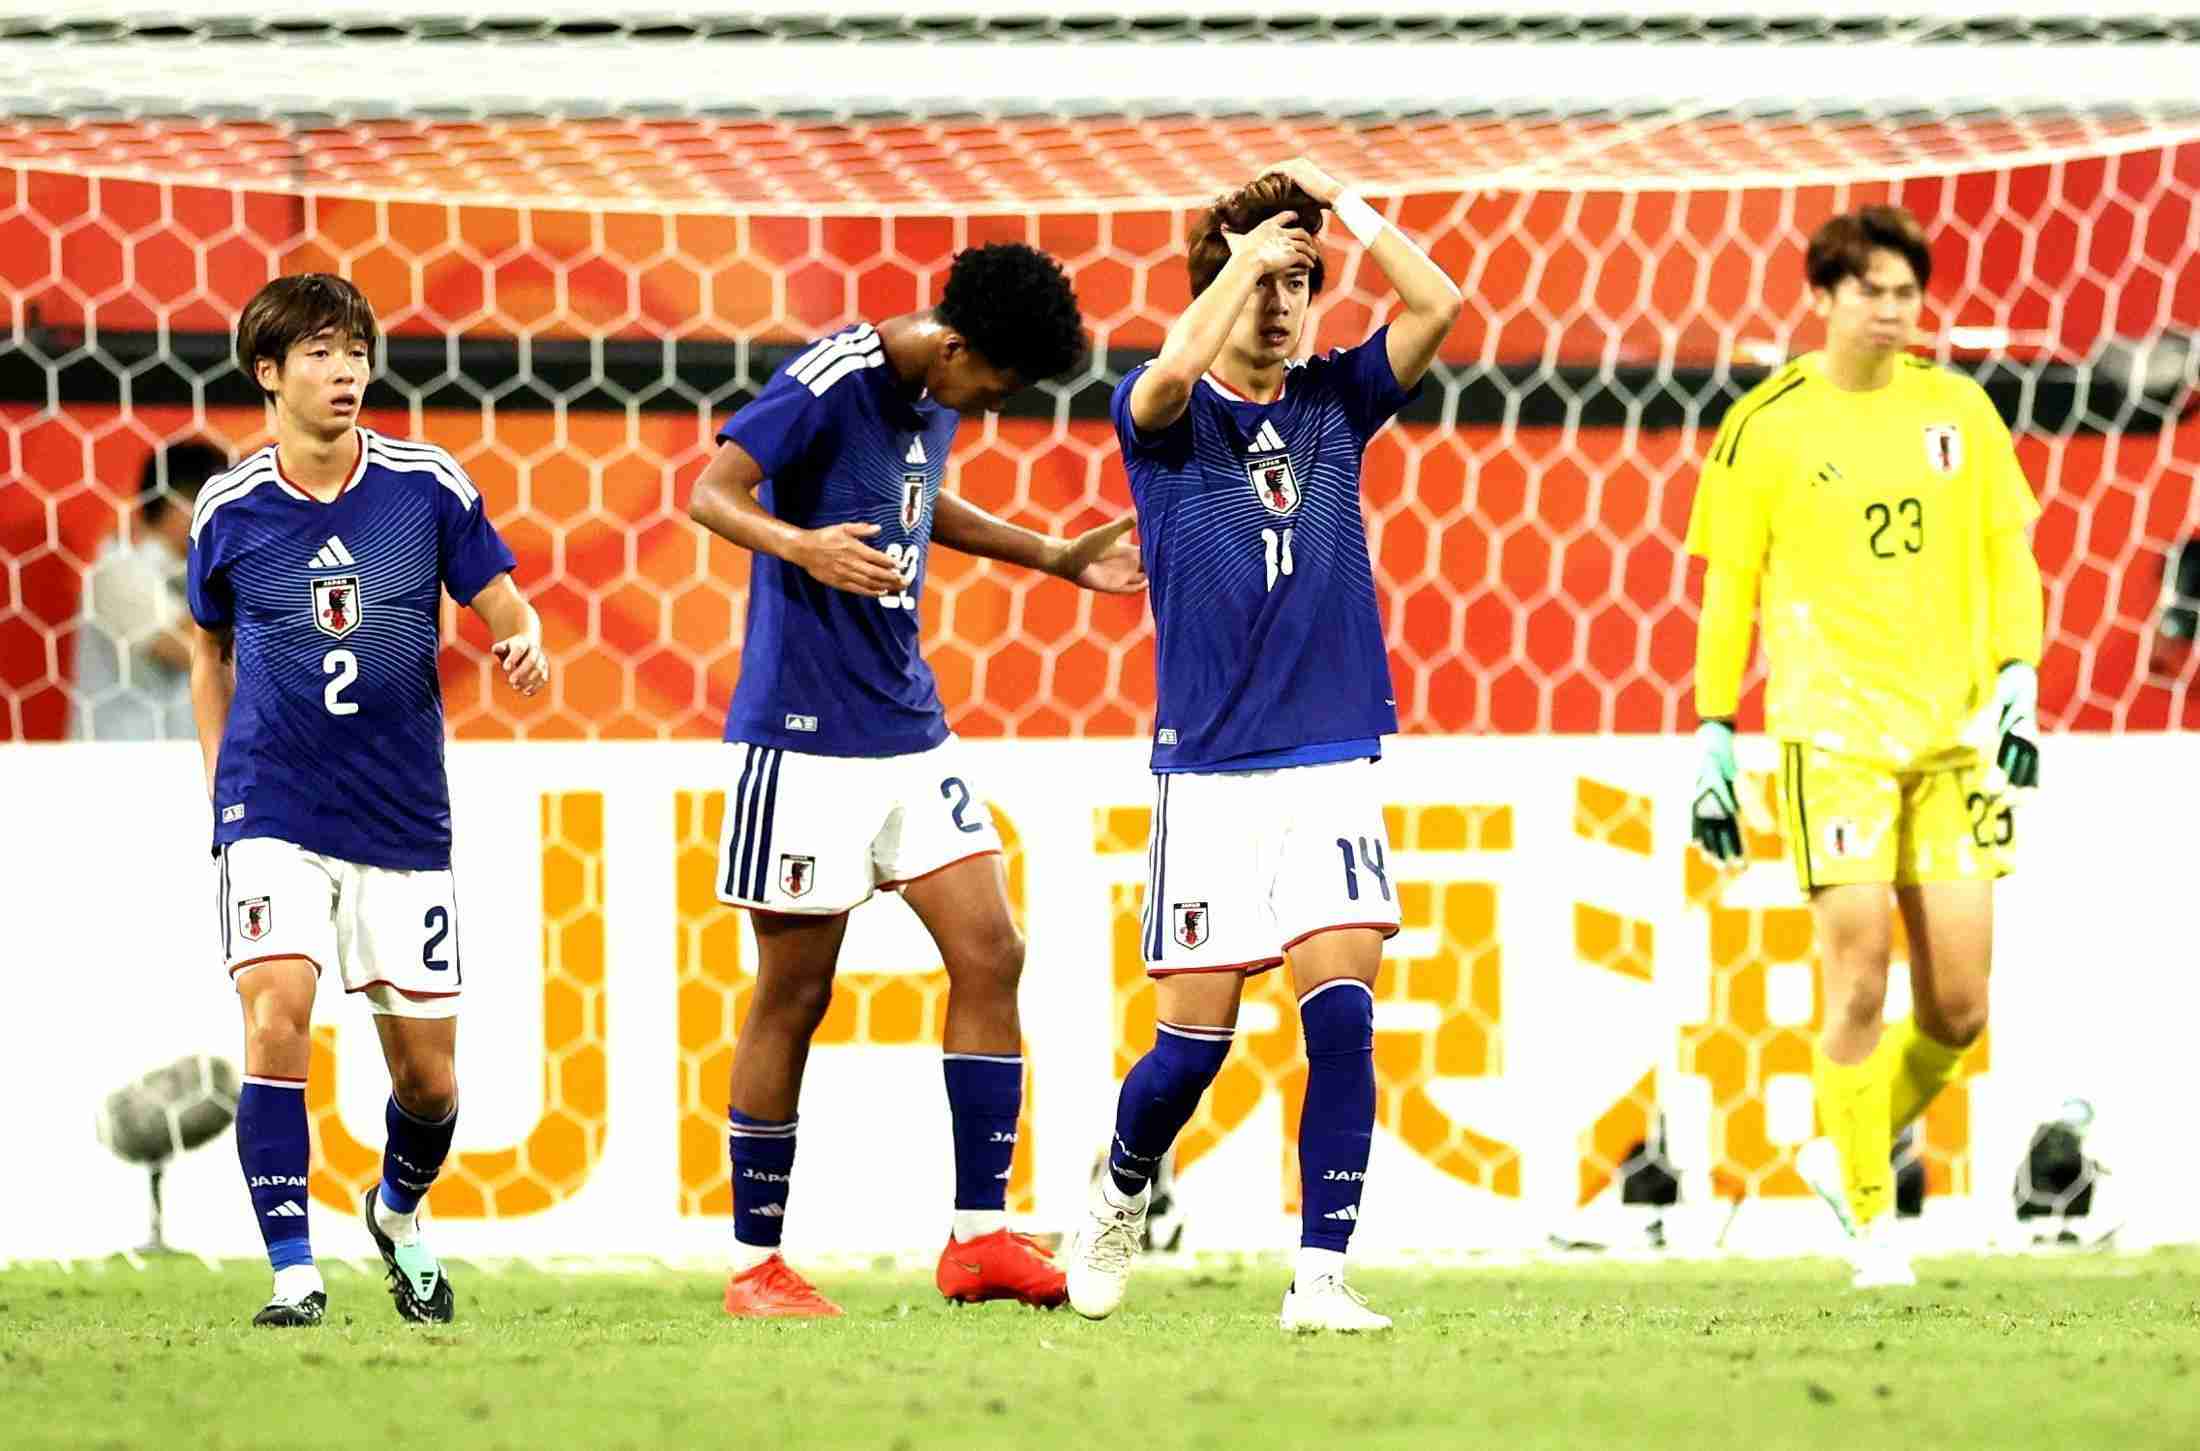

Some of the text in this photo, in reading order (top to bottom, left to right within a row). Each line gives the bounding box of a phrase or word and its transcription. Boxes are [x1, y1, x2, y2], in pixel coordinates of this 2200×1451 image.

[1865, 497, 1923, 558] 23
[323, 649, 359, 715] 2
[940, 777, 983, 833] 2
[1966, 792, 2014, 848] 23
[1336, 836, 1391, 901] 14
[423, 905, 449, 971] 2
[250, 1174, 308, 1188] JAPAN
[1323, 1169, 1366, 1182] JAP
